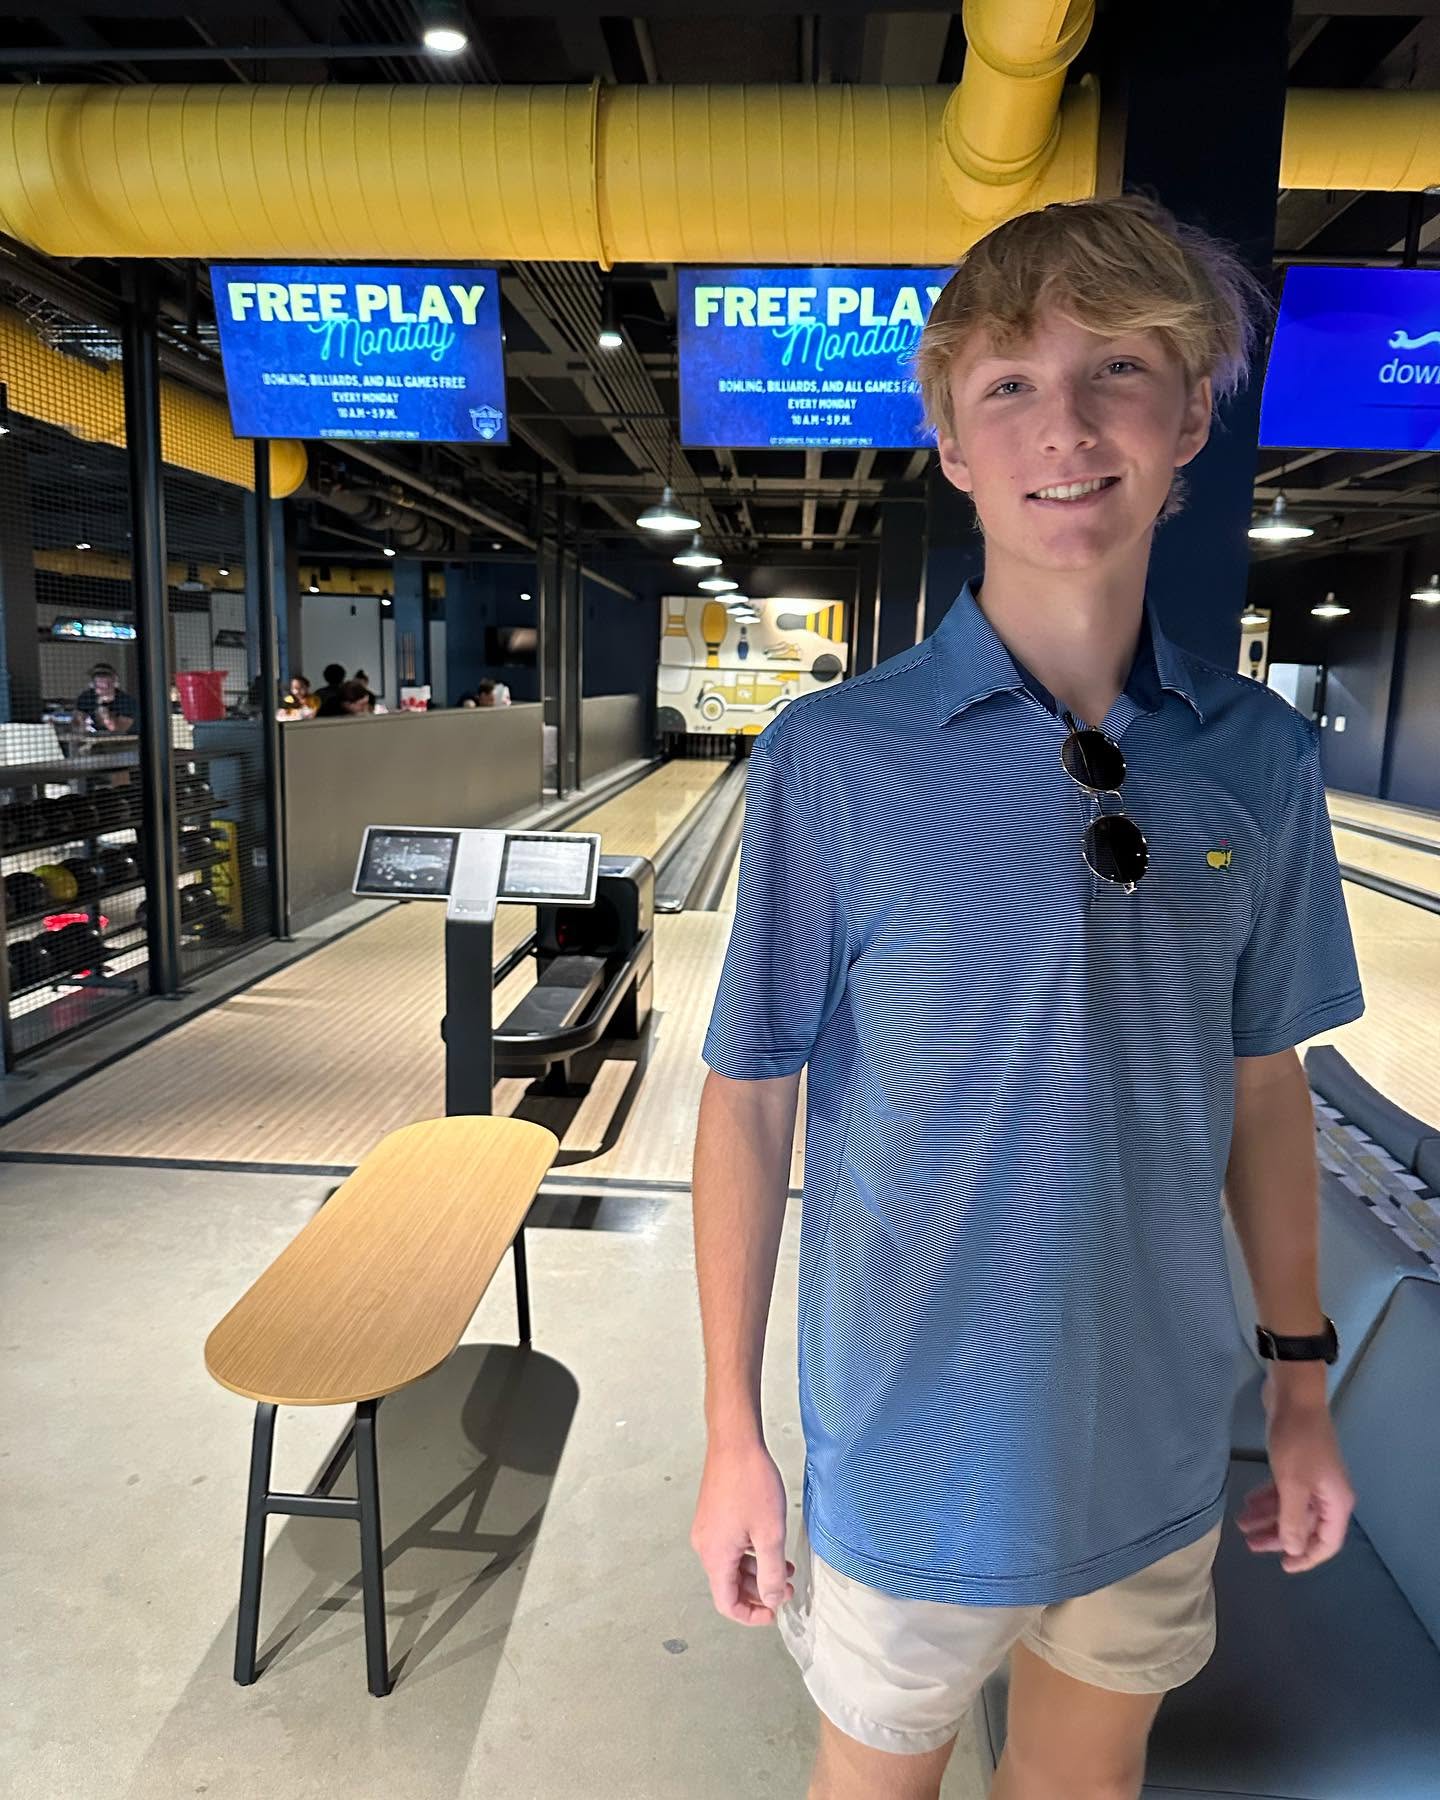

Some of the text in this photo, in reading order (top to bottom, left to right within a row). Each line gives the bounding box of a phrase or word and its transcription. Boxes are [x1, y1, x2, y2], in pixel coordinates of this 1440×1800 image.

[227, 282, 486, 325] FREE PLAY
[694, 286, 818, 327] FREE
[307, 317, 456, 367] Monday
[262, 372, 466, 389] BOWLING, BILLIARDS, AND ALL GAMES FREE
[1378, 358, 1440, 384] dow
[718, 379, 767, 393] BOWLING,
[767, 380, 820, 393] BILLIARDS,
[822, 380, 844, 393] AND
[845, 381, 864, 393] ALL
[864, 381, 901, 393] GAMES
[331, 391, 399, 404] EVERY MONDAY
[787, 398, 858, 410] EVERY MONDAY
